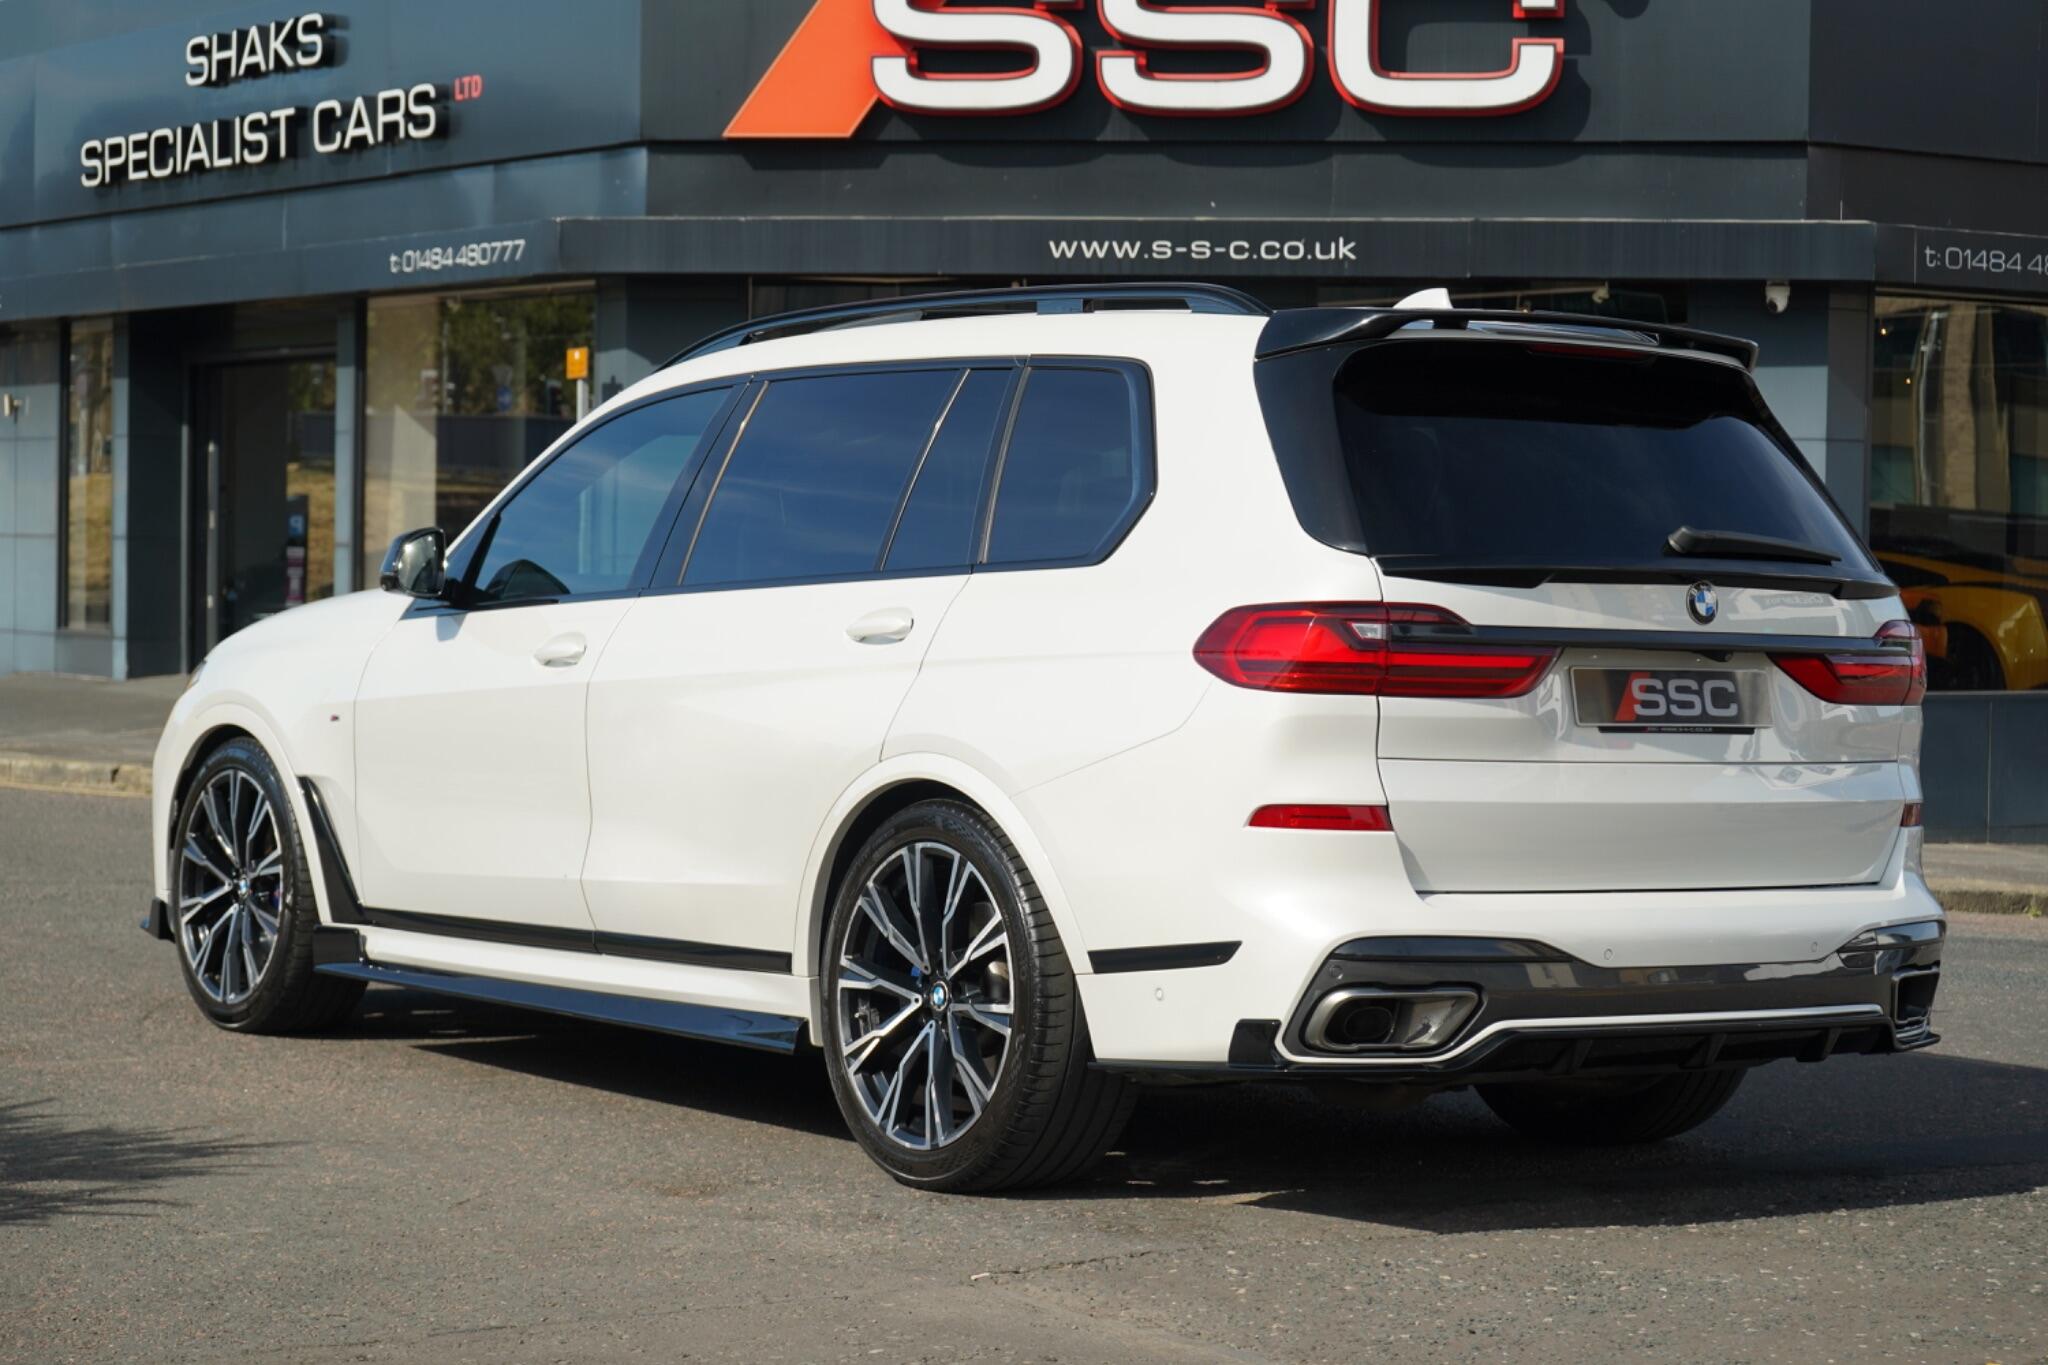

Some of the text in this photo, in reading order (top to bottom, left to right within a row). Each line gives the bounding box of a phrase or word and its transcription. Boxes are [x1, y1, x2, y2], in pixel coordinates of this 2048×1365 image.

[184, 12, 324, 87] SHAKS
[869, 0, 1565, 116] SSC
[80, 74, 483, 188] SPECIALIST CARS LTD
[455, 238, 526, 267] 480777
[1048, 236, 1358, 260] www.s-s-c.co.uk
[2026, 253, 2048, 276] 4
[1631, 678, 1739, 718] SSC
